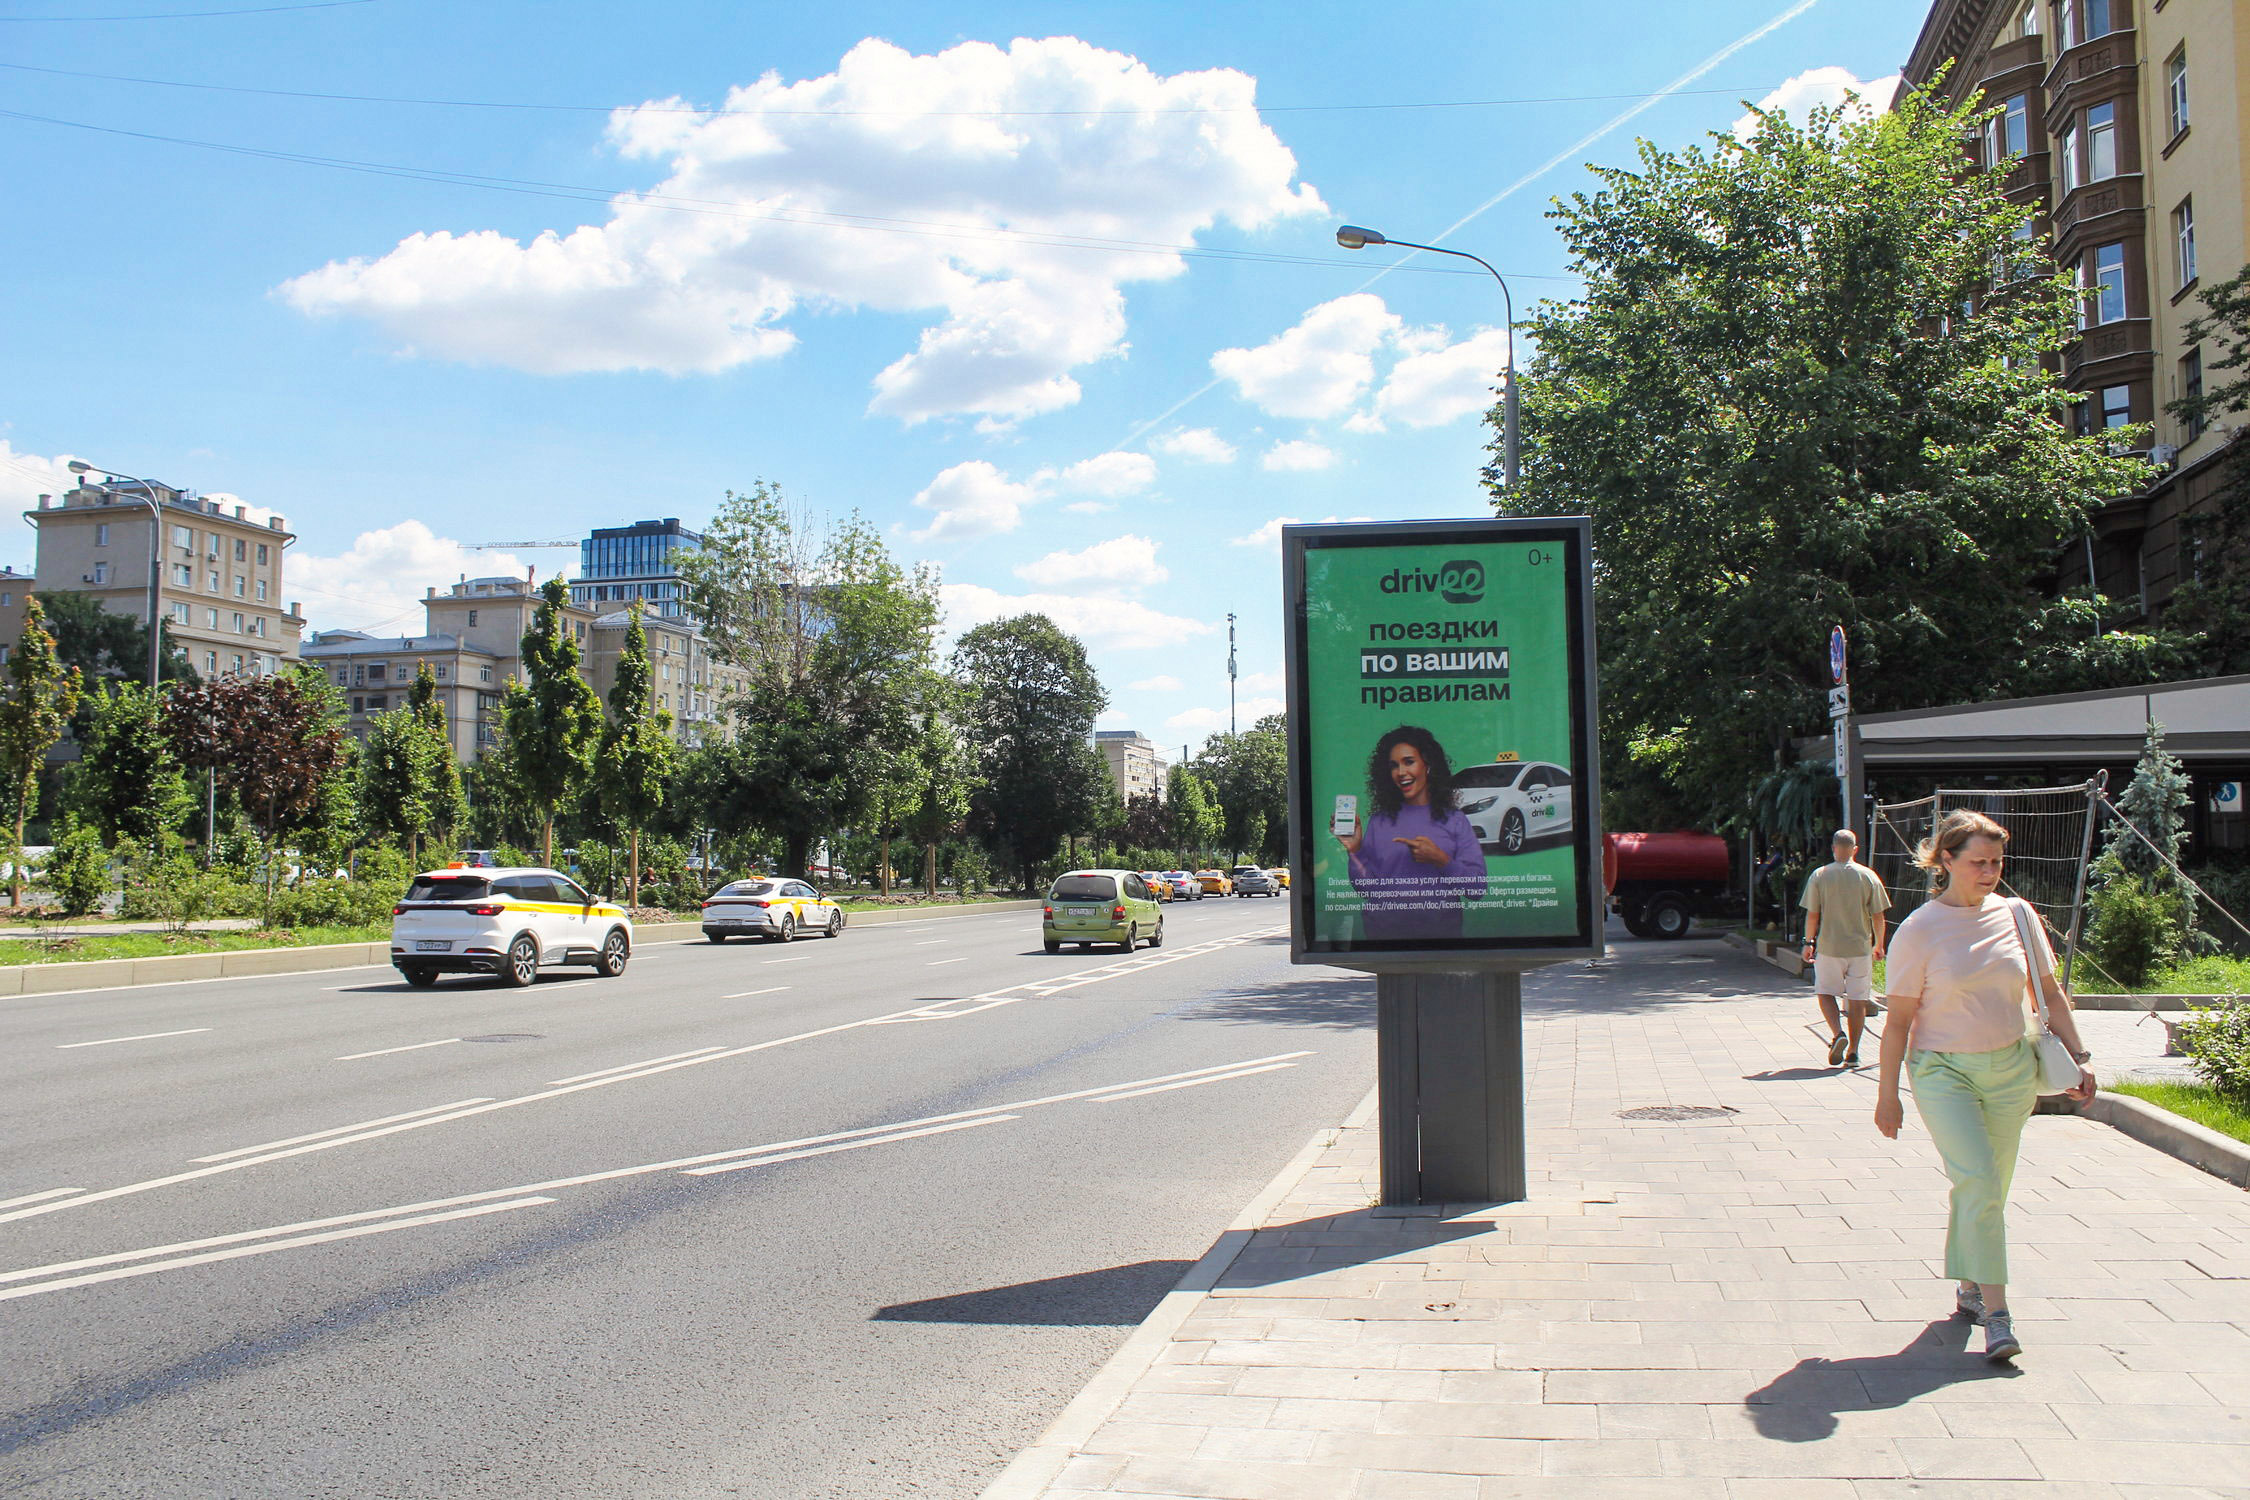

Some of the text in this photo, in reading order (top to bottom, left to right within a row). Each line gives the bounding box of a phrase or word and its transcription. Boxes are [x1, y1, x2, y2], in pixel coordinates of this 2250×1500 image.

[1528, 549, 1553, 566] 0+
[1380, 564, 1485, 598] drivee
[1369, 619, 1499, 643] поездки
[1361, 651, 1509, 673] по вашим
[1361, 682, 1511, 710] правилам
[1328, 877, 1350, 886] Drivee
[1355, 878, 1379, 887] сервис
[1380, 878, 1394, 886] для
[1395, 877, 1418, 885] заказа
[1420, 876, 1439, 886] услуг
[1440, 875, 1476, 885] перевозки
[1477, 875, 1519, 884] пассажиров
[1326, 890, 1335, 899] Не
[1336, 890, 1369, 899] является
[1370, 890, 1420, 899] перевозчиком
[1421, 889, 1434, 897] или
[1435, 888, 1465, 898] службой
[1489, 886, 1515, 896] Оферта
[1516, 886, 1556, 896] размещена
[1325, 904, 1334, 912] по
[1335, 903, 1361, 911] ссылке
